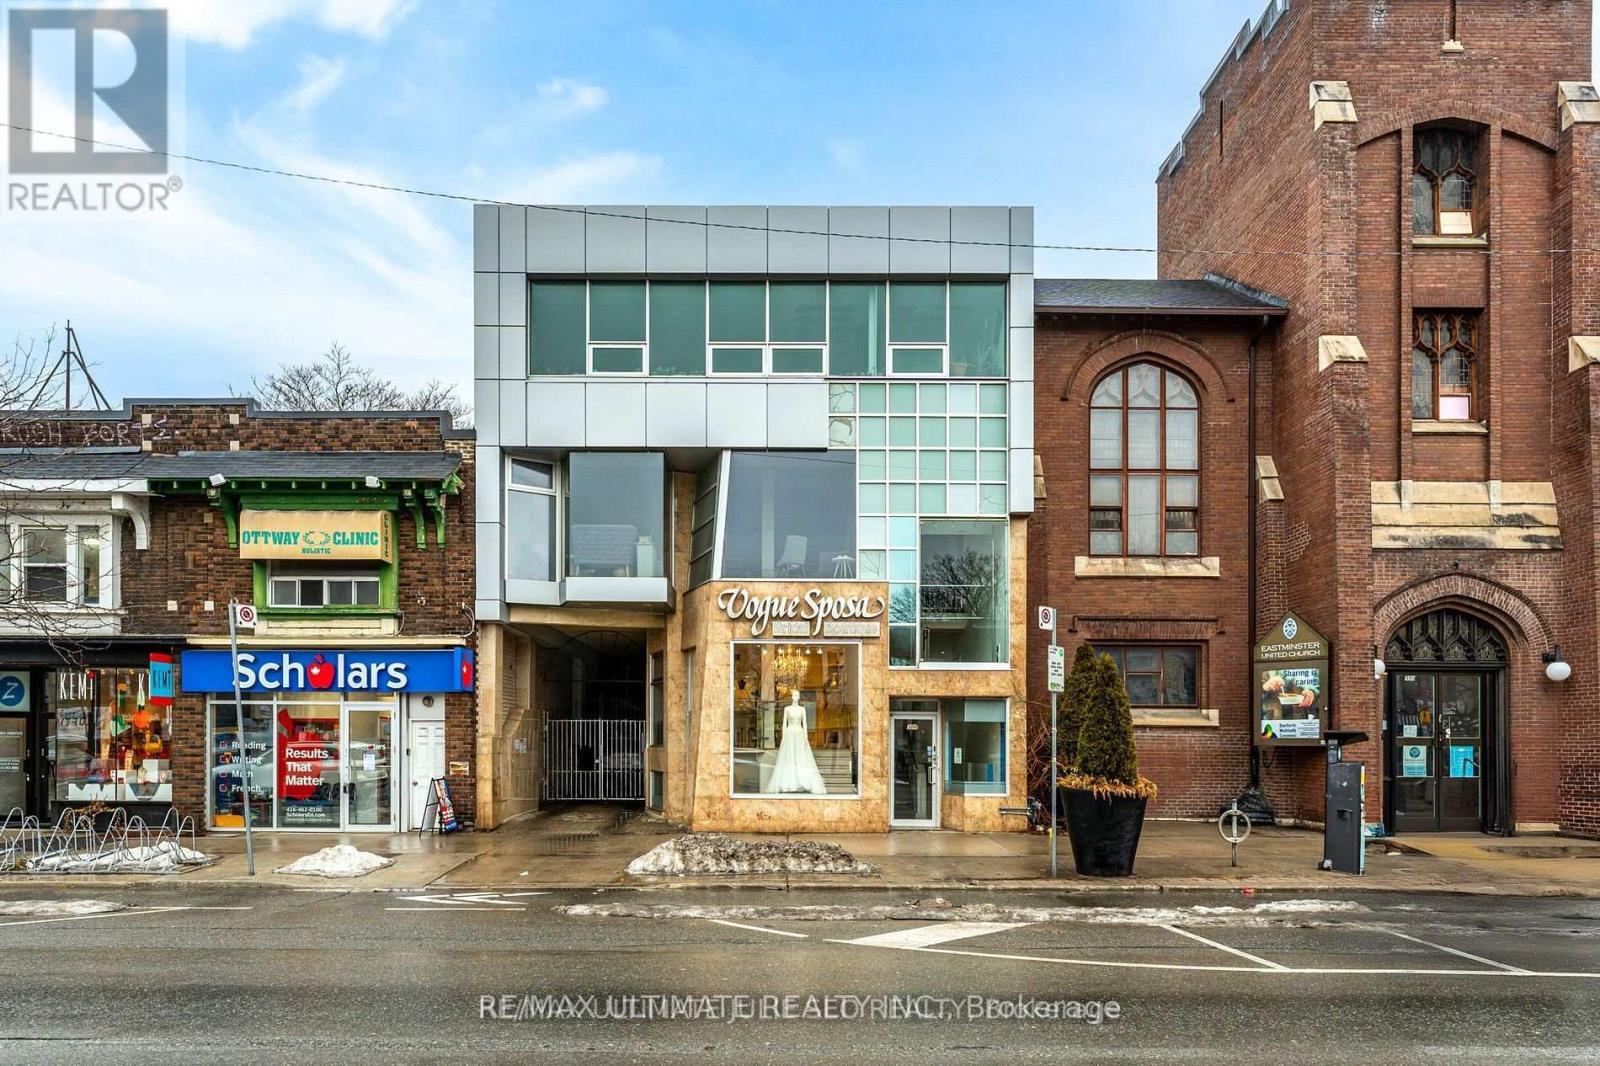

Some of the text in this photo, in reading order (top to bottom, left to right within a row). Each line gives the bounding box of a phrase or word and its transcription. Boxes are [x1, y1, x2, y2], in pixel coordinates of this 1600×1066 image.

[242, 530, 379, 546] OTTWAY CLINIC
[717, 588, 886, 637] Vogue Sposa
[1261, 641, 1320, 652] EASTMINSTER
[1261, 649, 1320, 659] UNITED CHURCH
[1283, 670, 1310, 678] Sharing
[285, 748, 329, 759] Results
[231, 755, 262, 765] Wting
[285, 761, 312, 772] That
[231, 769, 253, 778] Mah
[285, 775, 325, 786] Matter
